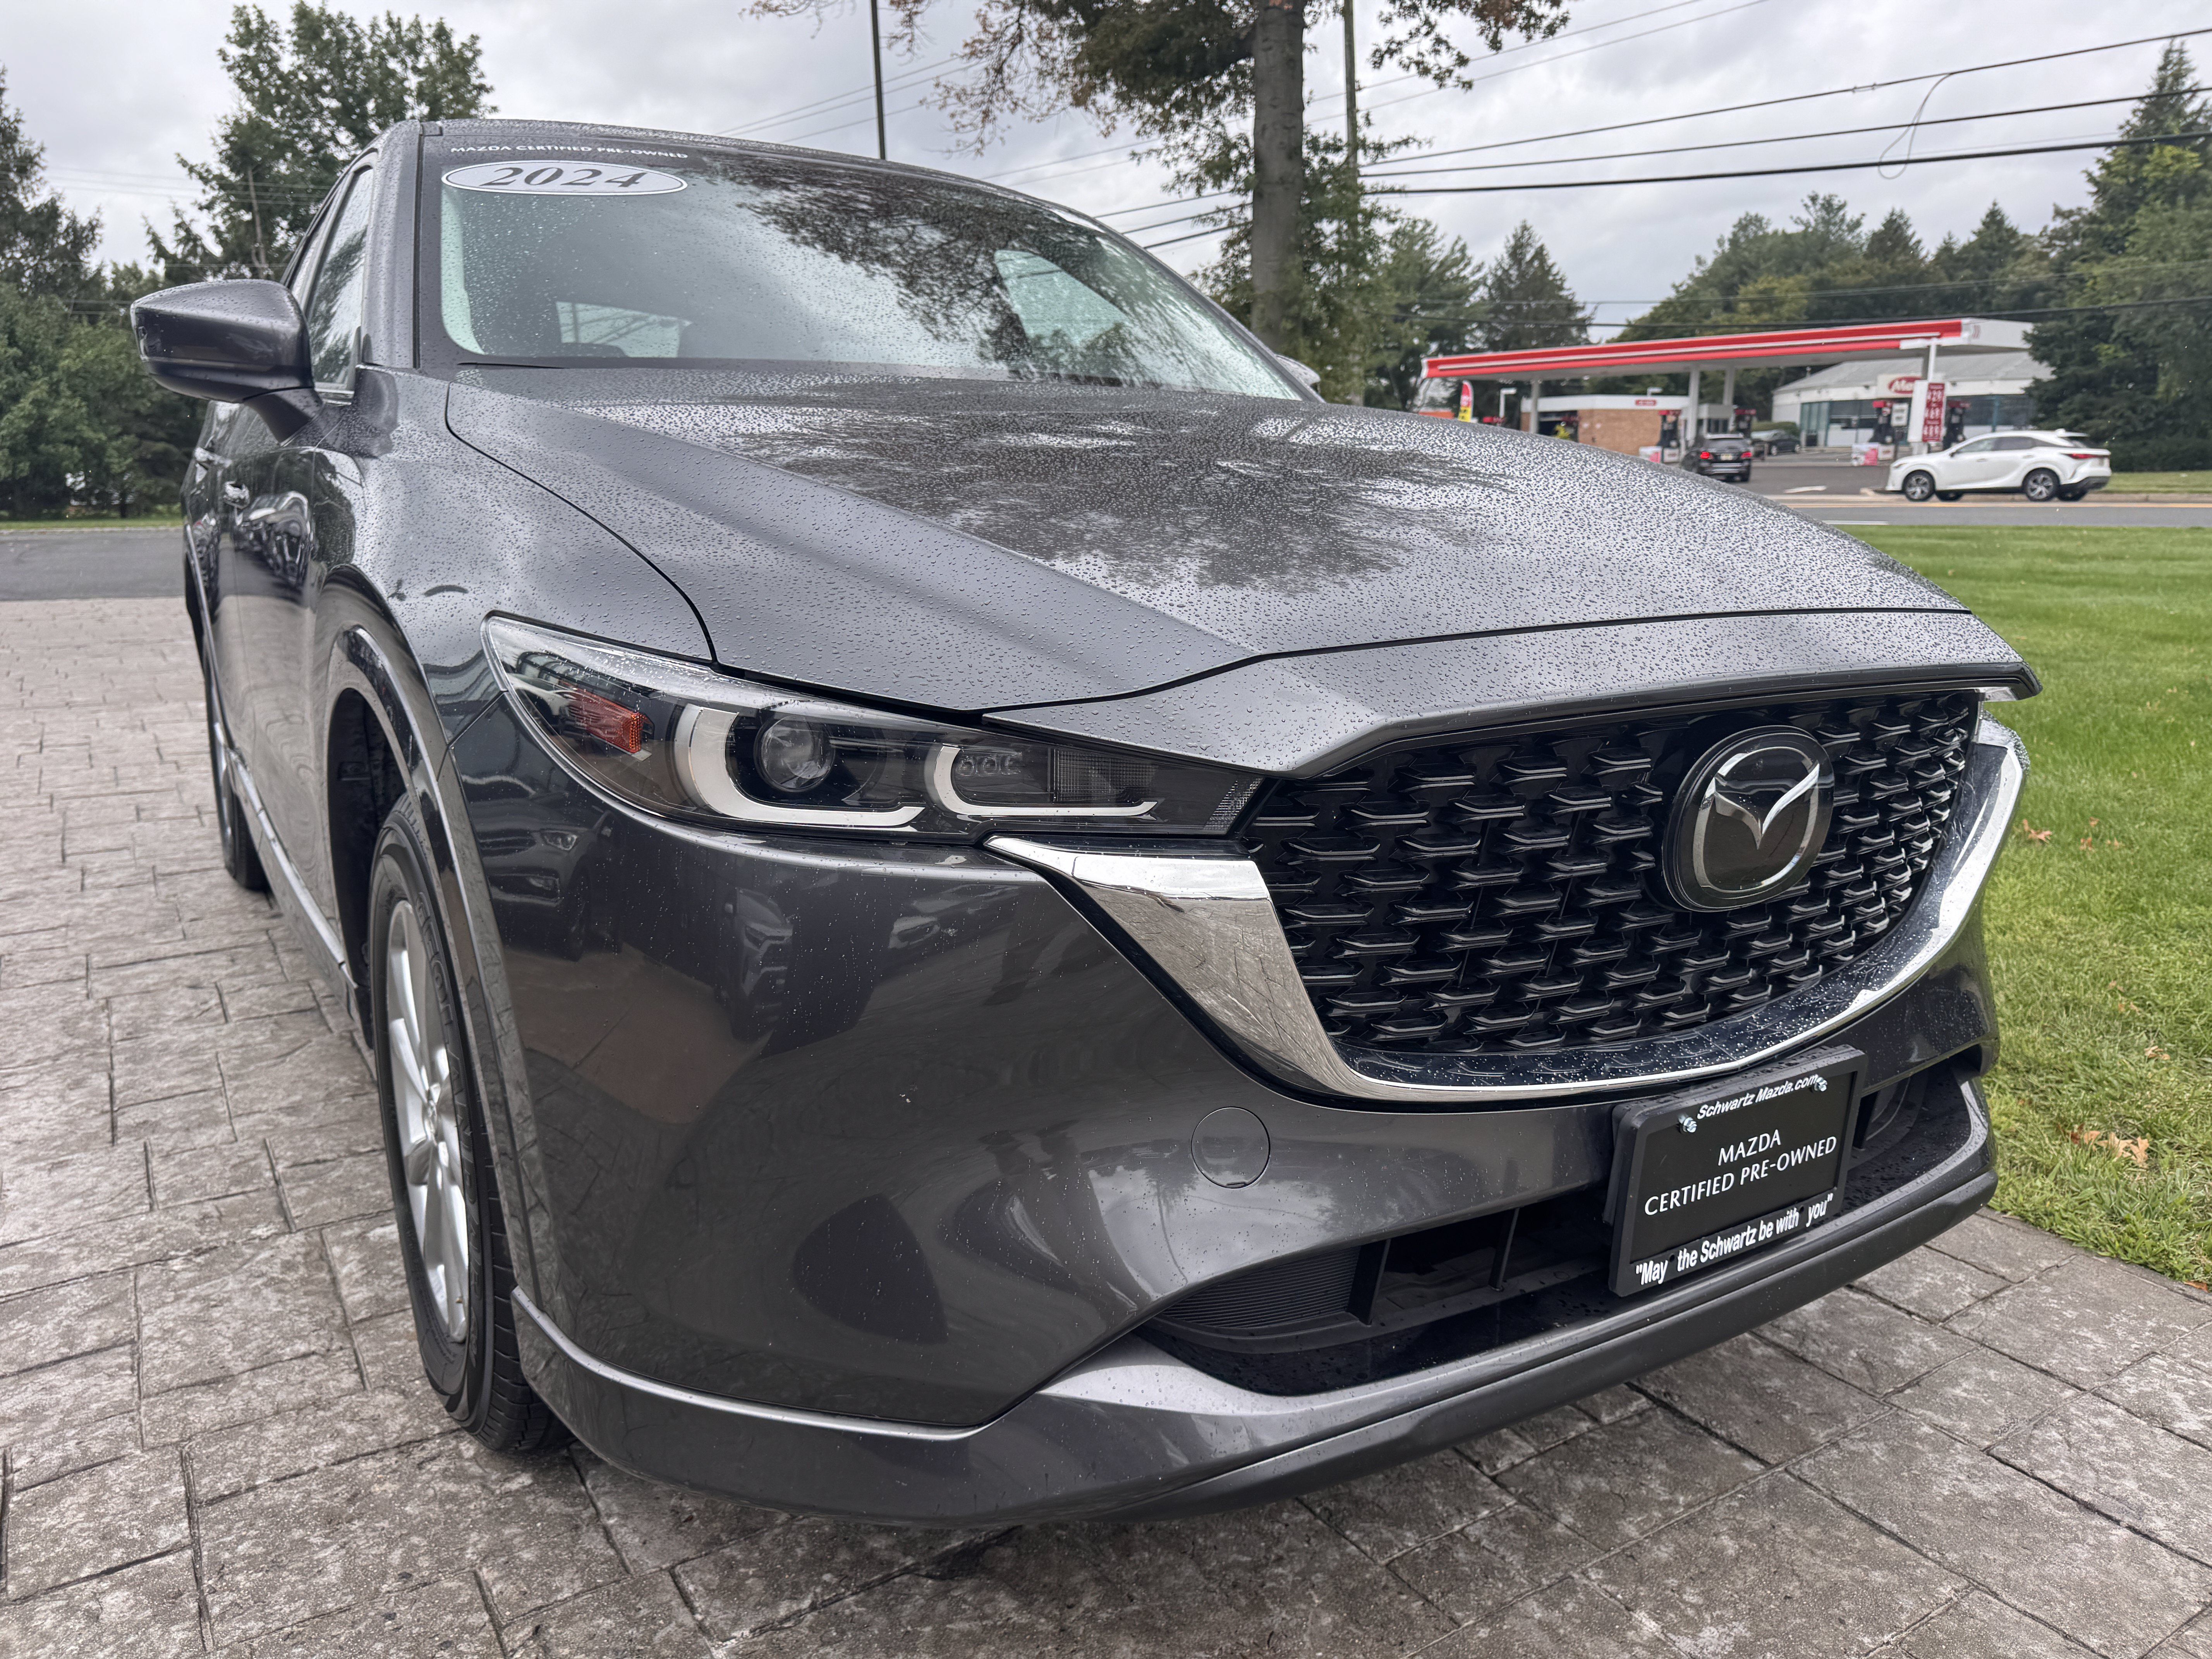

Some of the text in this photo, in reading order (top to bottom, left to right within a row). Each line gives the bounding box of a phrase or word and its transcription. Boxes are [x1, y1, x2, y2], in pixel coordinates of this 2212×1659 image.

[597, 147, 688, 158] PRE-OWNED
[479, 167, 648, 187] 2024
[1697, 1074, 1818, 1120] Schwartz Mazda.com
[1718, 1129, 1781, 1166] MAZDA
[1644, 1136, 1837, 1215] CERTIFIED PRE-OWNED
[1636, 1193, 1833, 1285] "May the Schwartz be with you"
